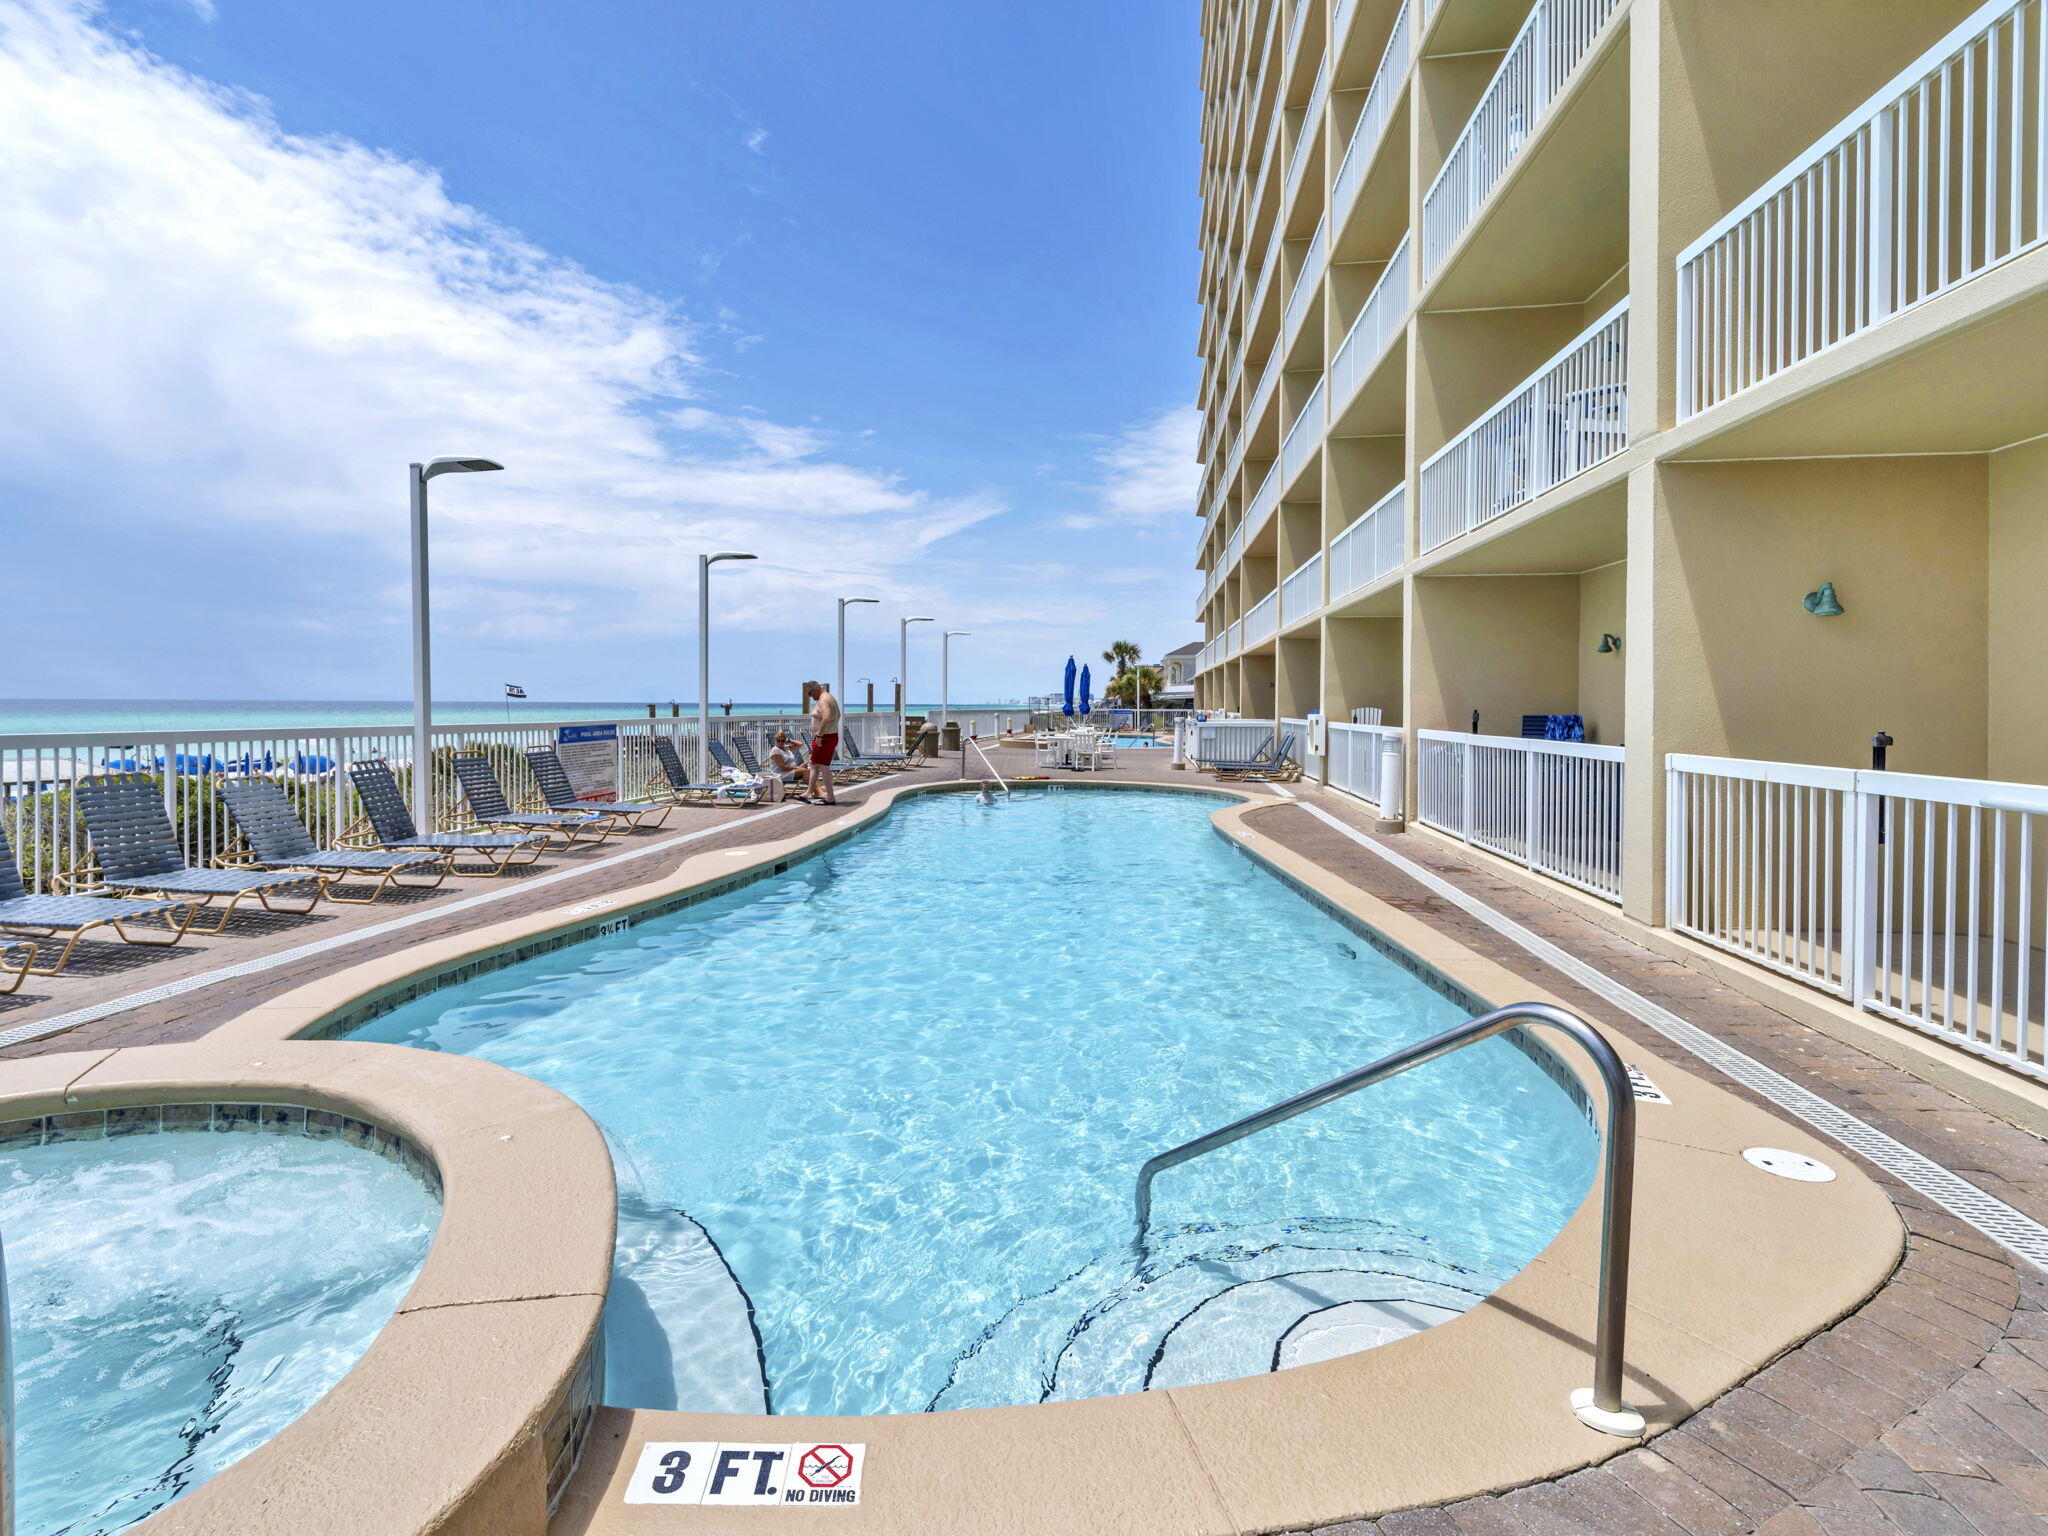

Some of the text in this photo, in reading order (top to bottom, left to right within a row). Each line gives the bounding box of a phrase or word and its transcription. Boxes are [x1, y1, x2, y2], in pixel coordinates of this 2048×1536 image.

[652, 1450, 784, 1495] 3 FT.
[785, 1489, 856, 1502] NO DIVING
